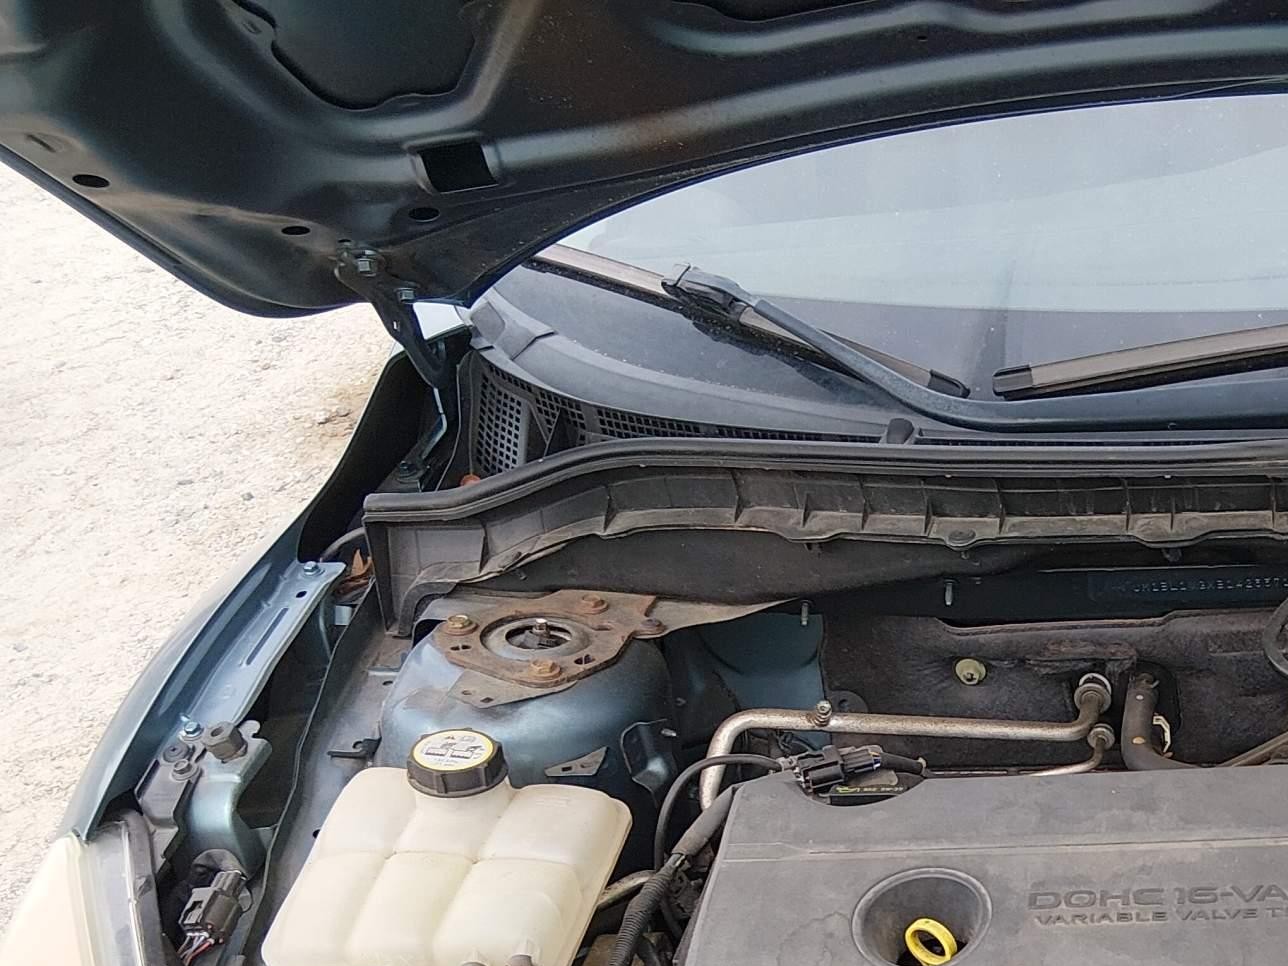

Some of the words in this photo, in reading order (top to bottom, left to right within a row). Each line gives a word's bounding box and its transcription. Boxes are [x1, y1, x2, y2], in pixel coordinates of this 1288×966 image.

[1028, 888, 1165, 910] DOHC
[1036, 911, 1168, 926] VARIABLE
[1181, 907, 1259, 921] VALVE
